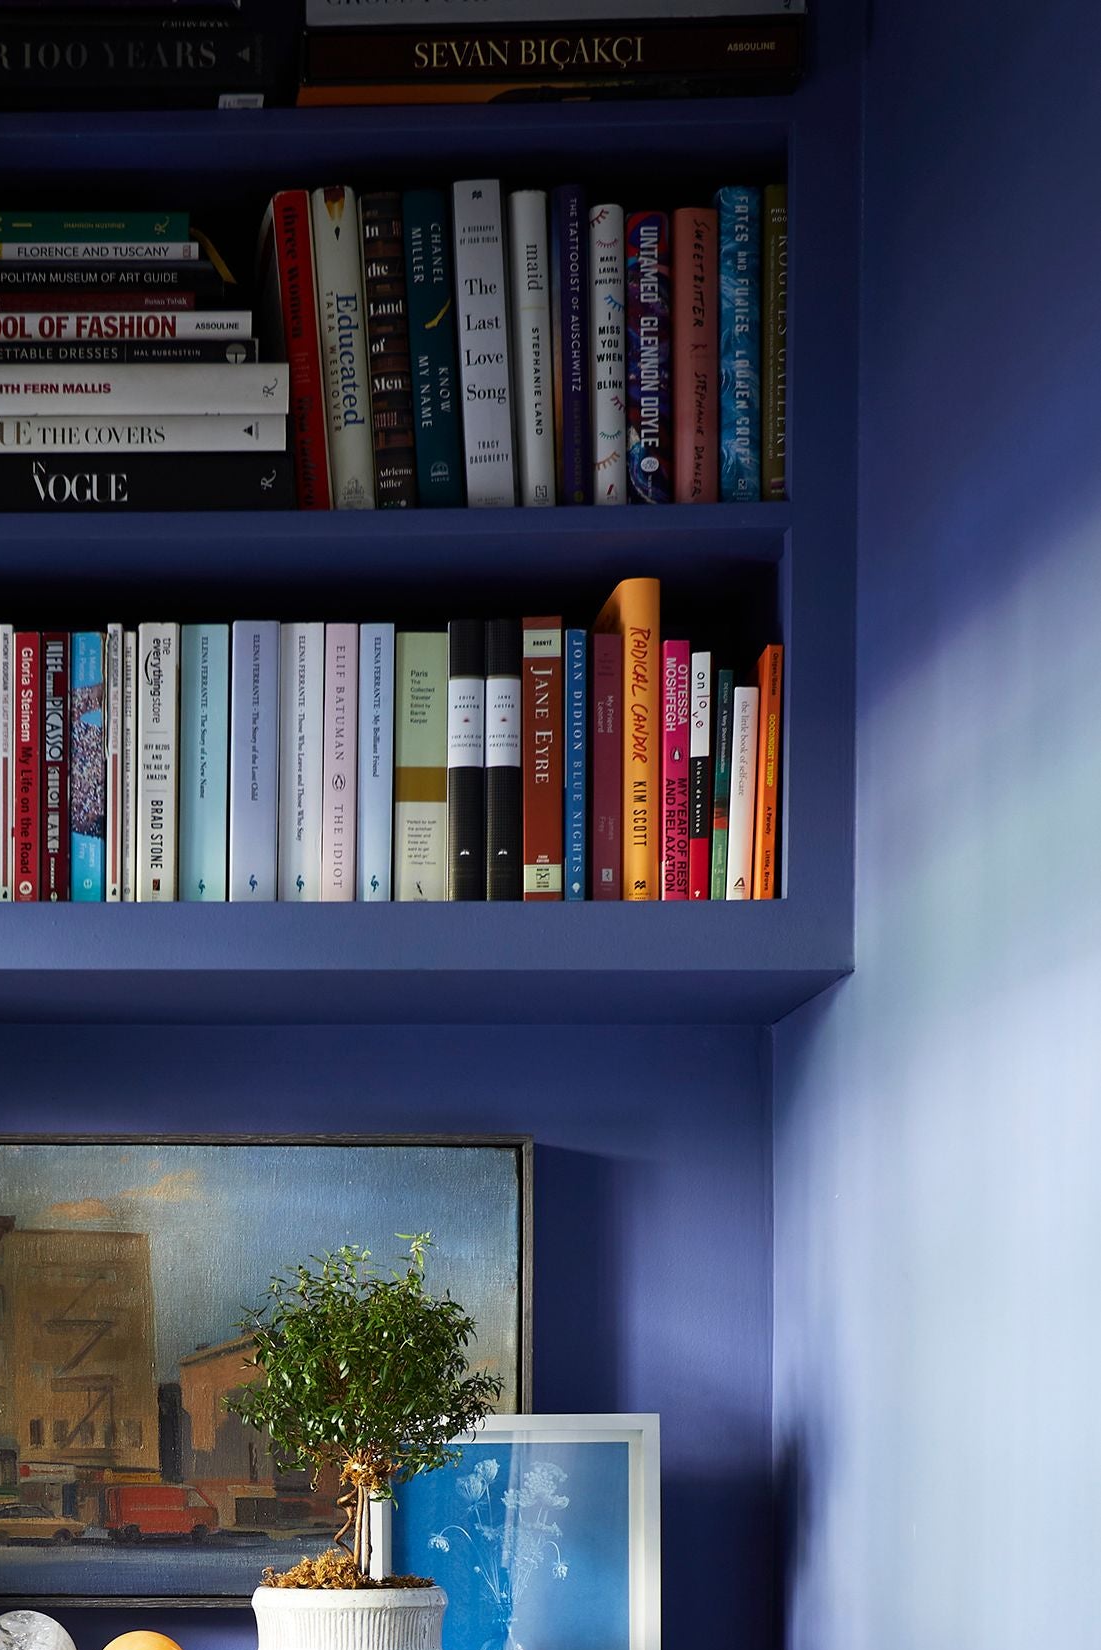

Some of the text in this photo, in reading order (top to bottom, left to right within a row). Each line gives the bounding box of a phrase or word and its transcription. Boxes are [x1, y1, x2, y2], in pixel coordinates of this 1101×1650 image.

[23, 42, 87, 70] 100
[99, 41, 217, 70] YEARS
[413, 37, 776, 70] SEVAN BIÇAKÇI ASSOULINE
[17, 246, 170, 257] FLORENCE AND TUSCANY
[411, 227, 425, 283] MILLER
[430, 223, 444, 284] CHANEL
[50, 272, 98, 283] MUSEUM
[101, 272, 115, 283] OF
[119, 272, 140, 283] ART
[144, 272, 179, 283] GUIDE
[465, 279, 497, 295] The
[38, 316, 69, 338] OF
[76, 316, 177, 338] FASHION
[195, 322, 240, 331] ASSOULINE
[466, 314, 501, 331] Last
[526, 244, 544, 436] maid STEPHANIE LAND
[598, 326, 621, 336] MISS
[601, 339, 619, 348] YOU
[639, 225, 660, 448] UNTAMED GLENNON DOYLE
[325, 290, 342, 433] TARA WESTOVER
[335, 293, 365, 426] Educated
[466, 349, 503, 365] Love
[597, 352, 623, 362] WHEN
[691, 219, 710, 497] SWEETBITTER STEPHANIE DANLER
[24, 383, 59, 394] FERN
[62, 383, 112, 393] MALLIS
[419, 355, 433, 428] MY NAME
[438, 367, 451, 413] KNOW
[467, 384, 507, 404] Song
[597, 380, 623, 390] BLINK
[37, 427, 80, 444] THE
[84, 426, 166, 444] COVERS
[477, 441, 499, 450] TRACY
[33, 473, 128, 503] VOGUE
[664, 656, 678, 732] MOSHFEGH
[677, 663, 689, 725] OTTESSA
[531, 666, 553, 784] JANE EYRE
[630, 627, 653, 847] RADICAL CANDOR KIM SCOTT
[18, 647, 33, 874] Gloria Steinem My Life on the Road
[332, 644, 346, 888] ELIF BATUMAN THE IDIOT
[572, 640, 584, 873] JOAN DIDION BLUE NIGHTS
[150, 799, 163, 870] BRAD STONE
[665, 777, 676, 892] AND RELAXATION
[676, 777, 687, 895] MY YEAR OF REST
